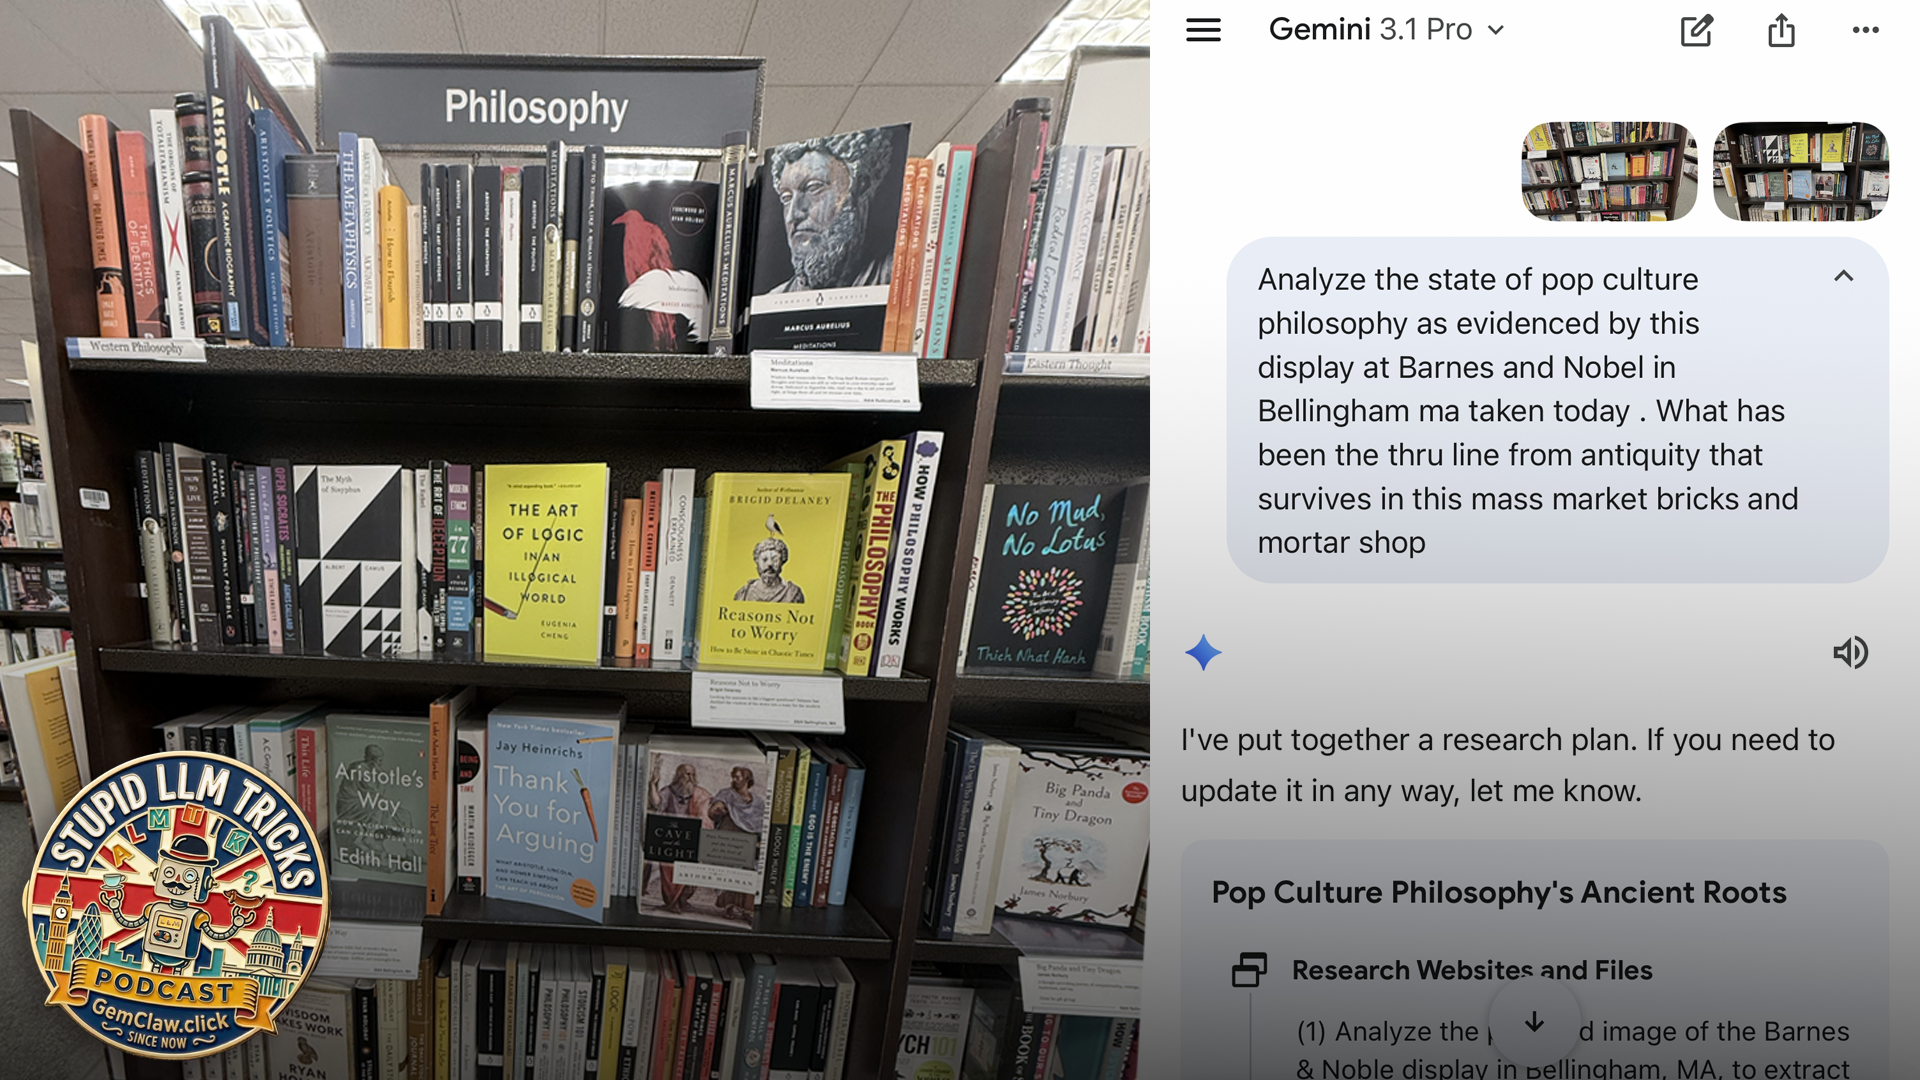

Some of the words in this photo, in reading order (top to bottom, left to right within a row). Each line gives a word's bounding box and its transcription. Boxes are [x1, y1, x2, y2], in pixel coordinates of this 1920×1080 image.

[1270, 17, 1370, 40] Gemini
[1380, 17, 1415, 40] 3.1
[1428, 17, 1472, 40] Pro
[445, 89, 629, 132] Philosophy
[210, 95, 230, 196] ARISTOTLE
[156, 120, 170, 204] TOTALITARIANISM
[260, 129, 273, 203] ARISTOTLE'S
[343, 150, 354, 182] THE
[170, 182, 177, 192] OF
[727, 168, 736, 207] MARCUS
[1086, 154, 1100, 205] RADICAL
[899, 183, 912, 247] MEDITATIONS
[912, 185, 925, 249] MEDITATIONS
[128, 221, 138, 237] OF
[139, 224, 149, 247] THE
[222, 210, 232, 247] GRAPHIC
[265, 208, 275, 261] POLITICS
[343, 185, 357, 289] METAPHYSICS
[724, 208, 734, 256] AURELIUS
[1072, 209, 1092, 281] ACCEPTANCE
[130, 242, 144, 297] IDENTITY
[142, 252, 154, 295] ETHICS
[225, 248, 236, 297] BIOGRAPHY
[1258, 267, 1365, 296] Analyze
[1375, 267, 1418, 290] the
[1429, 269, 1496, 290] state
[1506, 267, 1533, 290] of
[1543, 273, 1593, 296] pop
[1603, 267, 1698, 290] culture
[719, 262, 730, 324] MEDITATIONS
[932, 256, 952, 354] MEDITATIONS
[784, 324, 814, 332] MARCUS
[816, 321, 850, 330] AURELIUS
[1259, 311, 1408, 340] philosophy
[1417, 317, 1447, 334] as
[1457, 311, 1598, 334] evidenced
[1610, 311, 1641, 340] by
[1650, 311, 1699, 334] this
[90, 340, 129, 352] Western
[131, 342, 183, 355] Philosophy
[793, 342, 837, 350] MEDITATIONS
[1026, 359, 1066, 371] Eastern
[1070, 360, 1112, 372] Thought
[1258, 355, 1354, 384] display
[1364, 357, 1389, 378] at
[1400, 356, 1494, 379] Barnes
[1504, 355, 1553, 378] and
[1565, 355, 1643, 378] Nobel
[1654, 355, 1675, 378] in
[275, 466, 285, 491] OPEN
[321, 475, 334, 483] The
[335, 475, 352, 485] Myth
[433, 469, 442, 484] THE
[913, 465, 931, 500] HOW
[330, 487, 361, 495] Sisyphus
[433, 486, 443, 504] ART
[729, 496, 772, 504] BRIGID
[776, 496, 832, 505] DELANEY
[876, 491, 896, 502] THE
[277, 494, 290, 541] SOCRATES
[433, 505, 443, 515] OF
[509, 504, 540, 517] THE
[547, 504, 578, 517] ART
[1006, 502, 1039, 527] No
[1048, 493, 1106, 527] Mud,
[503, 527, 524, 540] OF
[532, 528, 584, 542] LOGIC
[669, 517, 677, 562] EXPLAINED
[676, 494, 686, 562] CONSCIOUSNESS
[432, 518, 445, 582] DECEPTION
[449, 536, 469, 554] 77
[899, 504, 922, 594] PHILOSOPHY
[1002, 532, 1035, 556] No
[1041, 526, 1106, 555] Lotus
[524, 552, 537, 561] IN
[542, 553, 560, 562] AN
[857, 504, 894, 620] PHILOSOPHY
[509, 572, 576, 583] ILLOGICAL
[520, 593, 566, 604] WORLD
[541, 620, 577, 628] EUGENIA
[718, 606, 782, 623] Reasons
[787, 610, 815, 625] Not
[855, 621, 875, 629] BOOK
[888, 597, 906, 646] WORKS
[541, 632, 569, 640] CHENG
[731, 627, 746, 639] to
[750, 626, 798, 645] Worry
[768, 649, 793, 657] Chaotic
[977, 646, 1012, 662] Thich
[1016, 649, 1049, 663] Nhat
[1053, 648, 1086, 665] Hanh
[459, 755, 478, 764] BEING
[495, 740, 518, 754] Jay
[522, 743, 583, 759] Heinrichs
[335, 762, 424, 789] Aristotle's
[460, 770, 473, 778] AND
[493, 764, 569, 794] Thank
[460, 785, 474, 793] TIME
[1045, 782, 1067, 798] Big
[1072, 784, 1111, 799] Panda
[357, 790, 401, 817] Way
[493, 793, 538, 819] You
[547, 799, 581, 825] for
[1065, 799, 1083, 807] and
[357, 821, 389, 830] ANCIENT
[391, 826, 423, 835] WISDOM
[1033, 806, 1060, 823] Tiny
[1065, 810, 1113, 827] Dragon
[354, 830, 384, 839] CHANGE
[387, 834, 406, 842] YOUR
[496, 823, 595, 864] Arguing
[654, 827, 692, 840] CAVE
[339, 847, 381, 867] Edith
[388, 853, 422, 873] Hall
[649, 846, 695, 859] LIGHT
[1019, 886, 1046, 898] James
[1049, 890, 1089, 904] Norbury
[1214, 880, 1265, 910] Pop
[1275, 880, 1382, 903] Culture
[1393, 880, 1573, 910] Philosophy's
[1581, 880, 1694, 903] Ancient
[1705, 880, 1787, 903] Roots
[609, 985, 619, 1013] LOGIC
